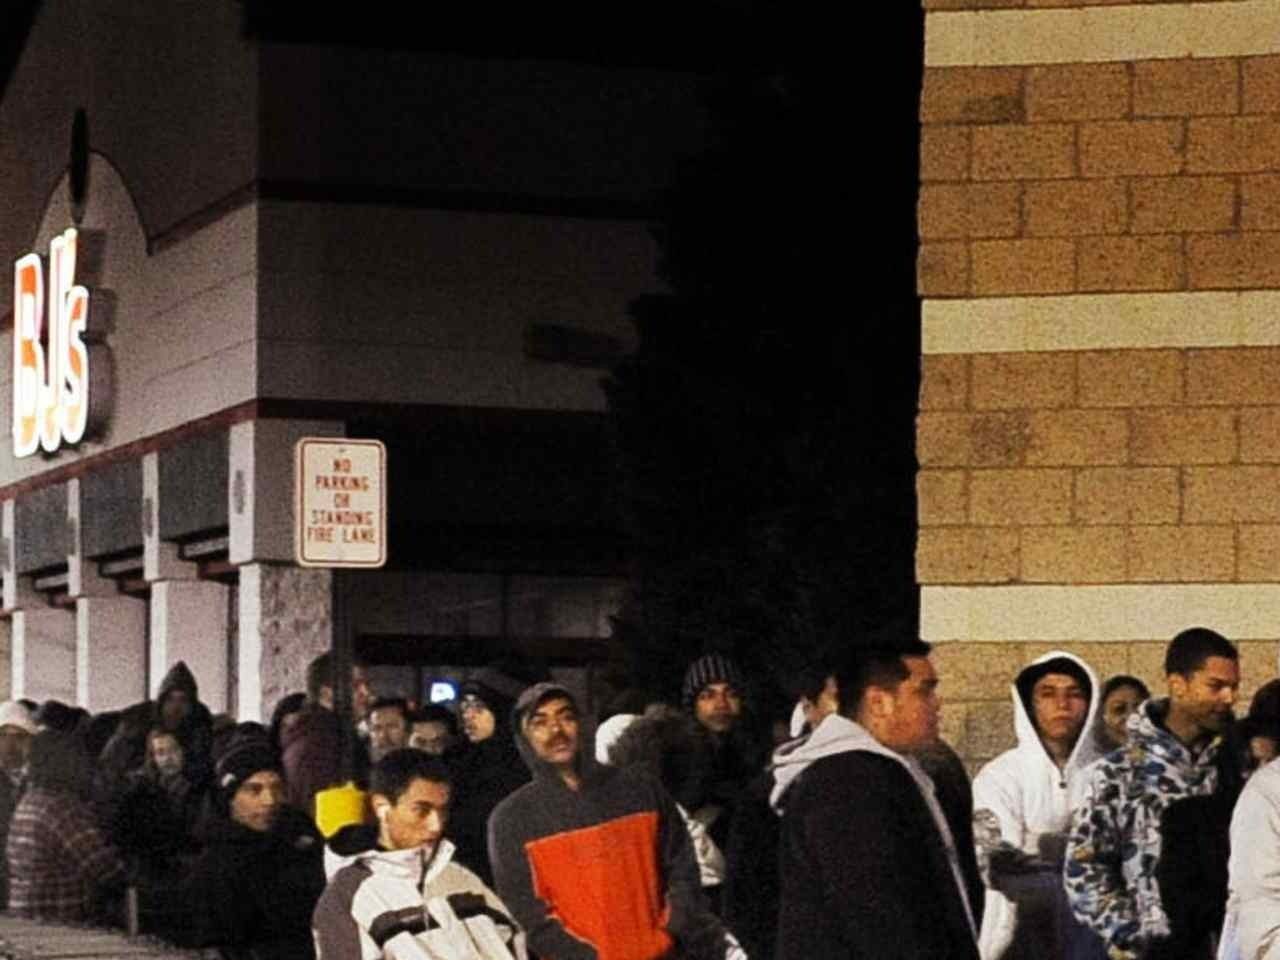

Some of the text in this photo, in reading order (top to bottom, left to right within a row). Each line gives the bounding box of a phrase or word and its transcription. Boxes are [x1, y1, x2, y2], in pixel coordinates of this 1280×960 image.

[14, 229, 88, 457] BJ's
[334, 459, 351, 472] NO
[314, 476, 369, 490] PARKING
[334, 493, 350, 507] OR
[312, 510, 373, 524] STANDING
[307, 527, 376, 543] FIRE LANE
